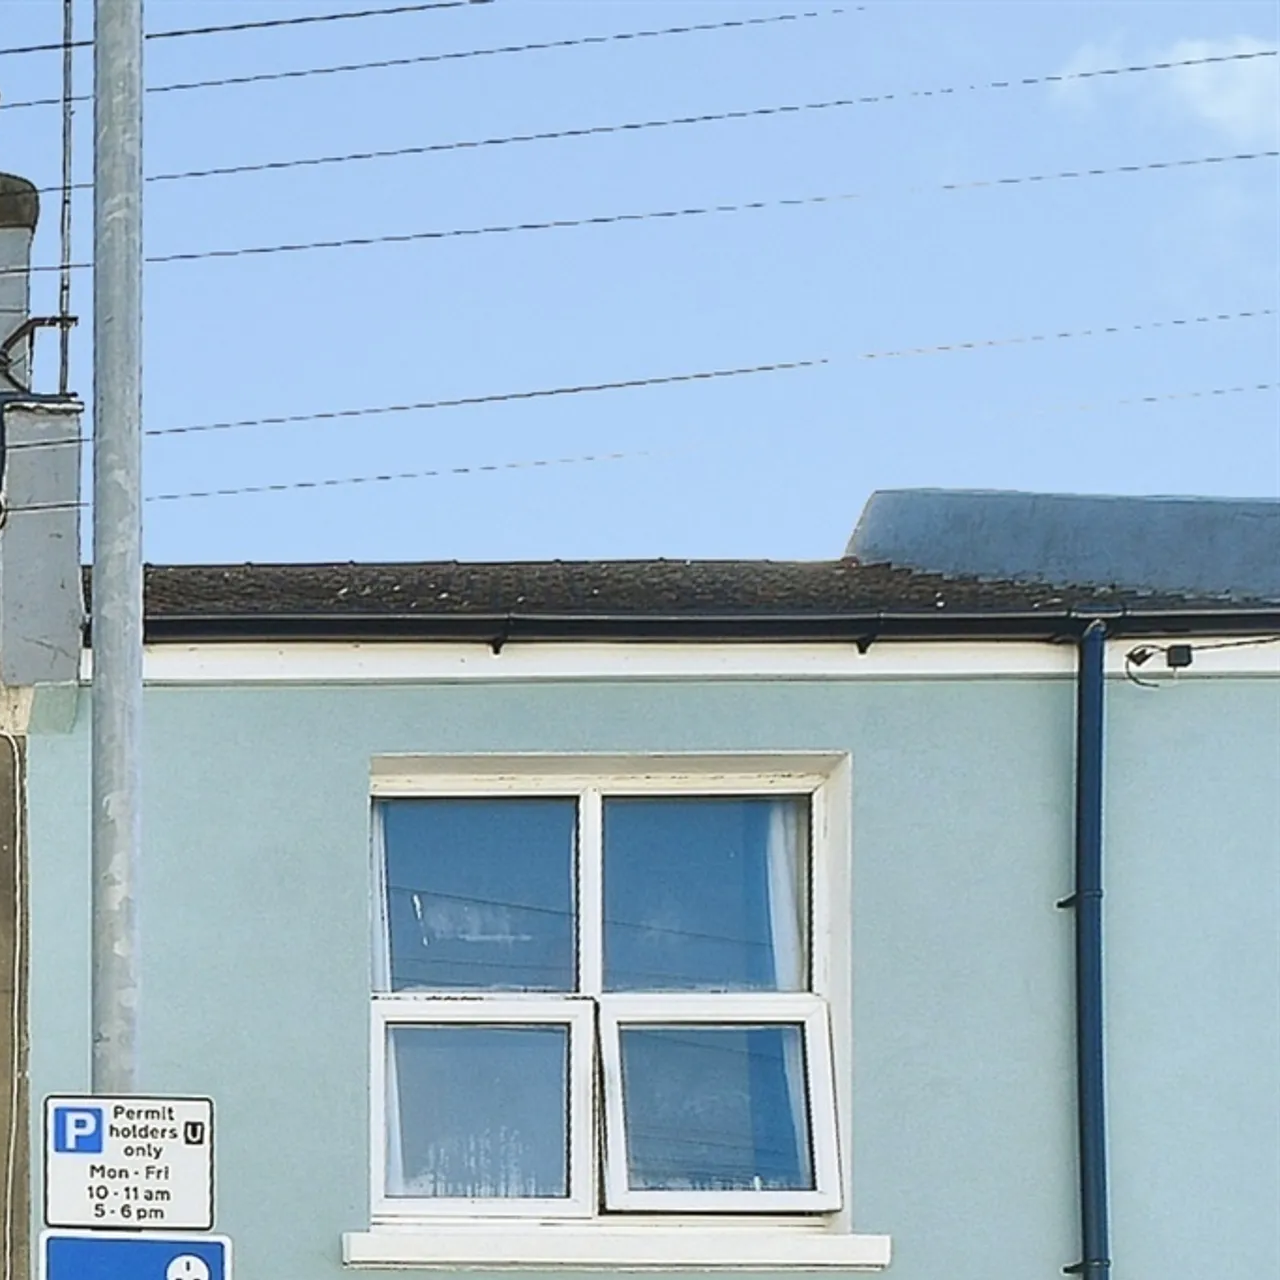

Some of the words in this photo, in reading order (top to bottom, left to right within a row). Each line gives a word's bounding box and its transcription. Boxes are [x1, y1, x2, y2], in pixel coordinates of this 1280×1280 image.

[113, 1105, 175, 1121] Permit
[65, 1112, 96, 1149] P
[109, 1124, 178, 1139] holders
[187, 1124, 202, 1143] U
[124, 1143, 163, 1159] only
[90, 1164, 129, 1179] Mon
[145, 1165, 169, 1180] Fri
[87, 1185, 109, 1200] 10
[144, 1189, 170, 1201] am
[94, 1203, 106, 1218] 5
[120, 1204, 132, 1218] 6
[137, 1208, 164, 1220] pm
